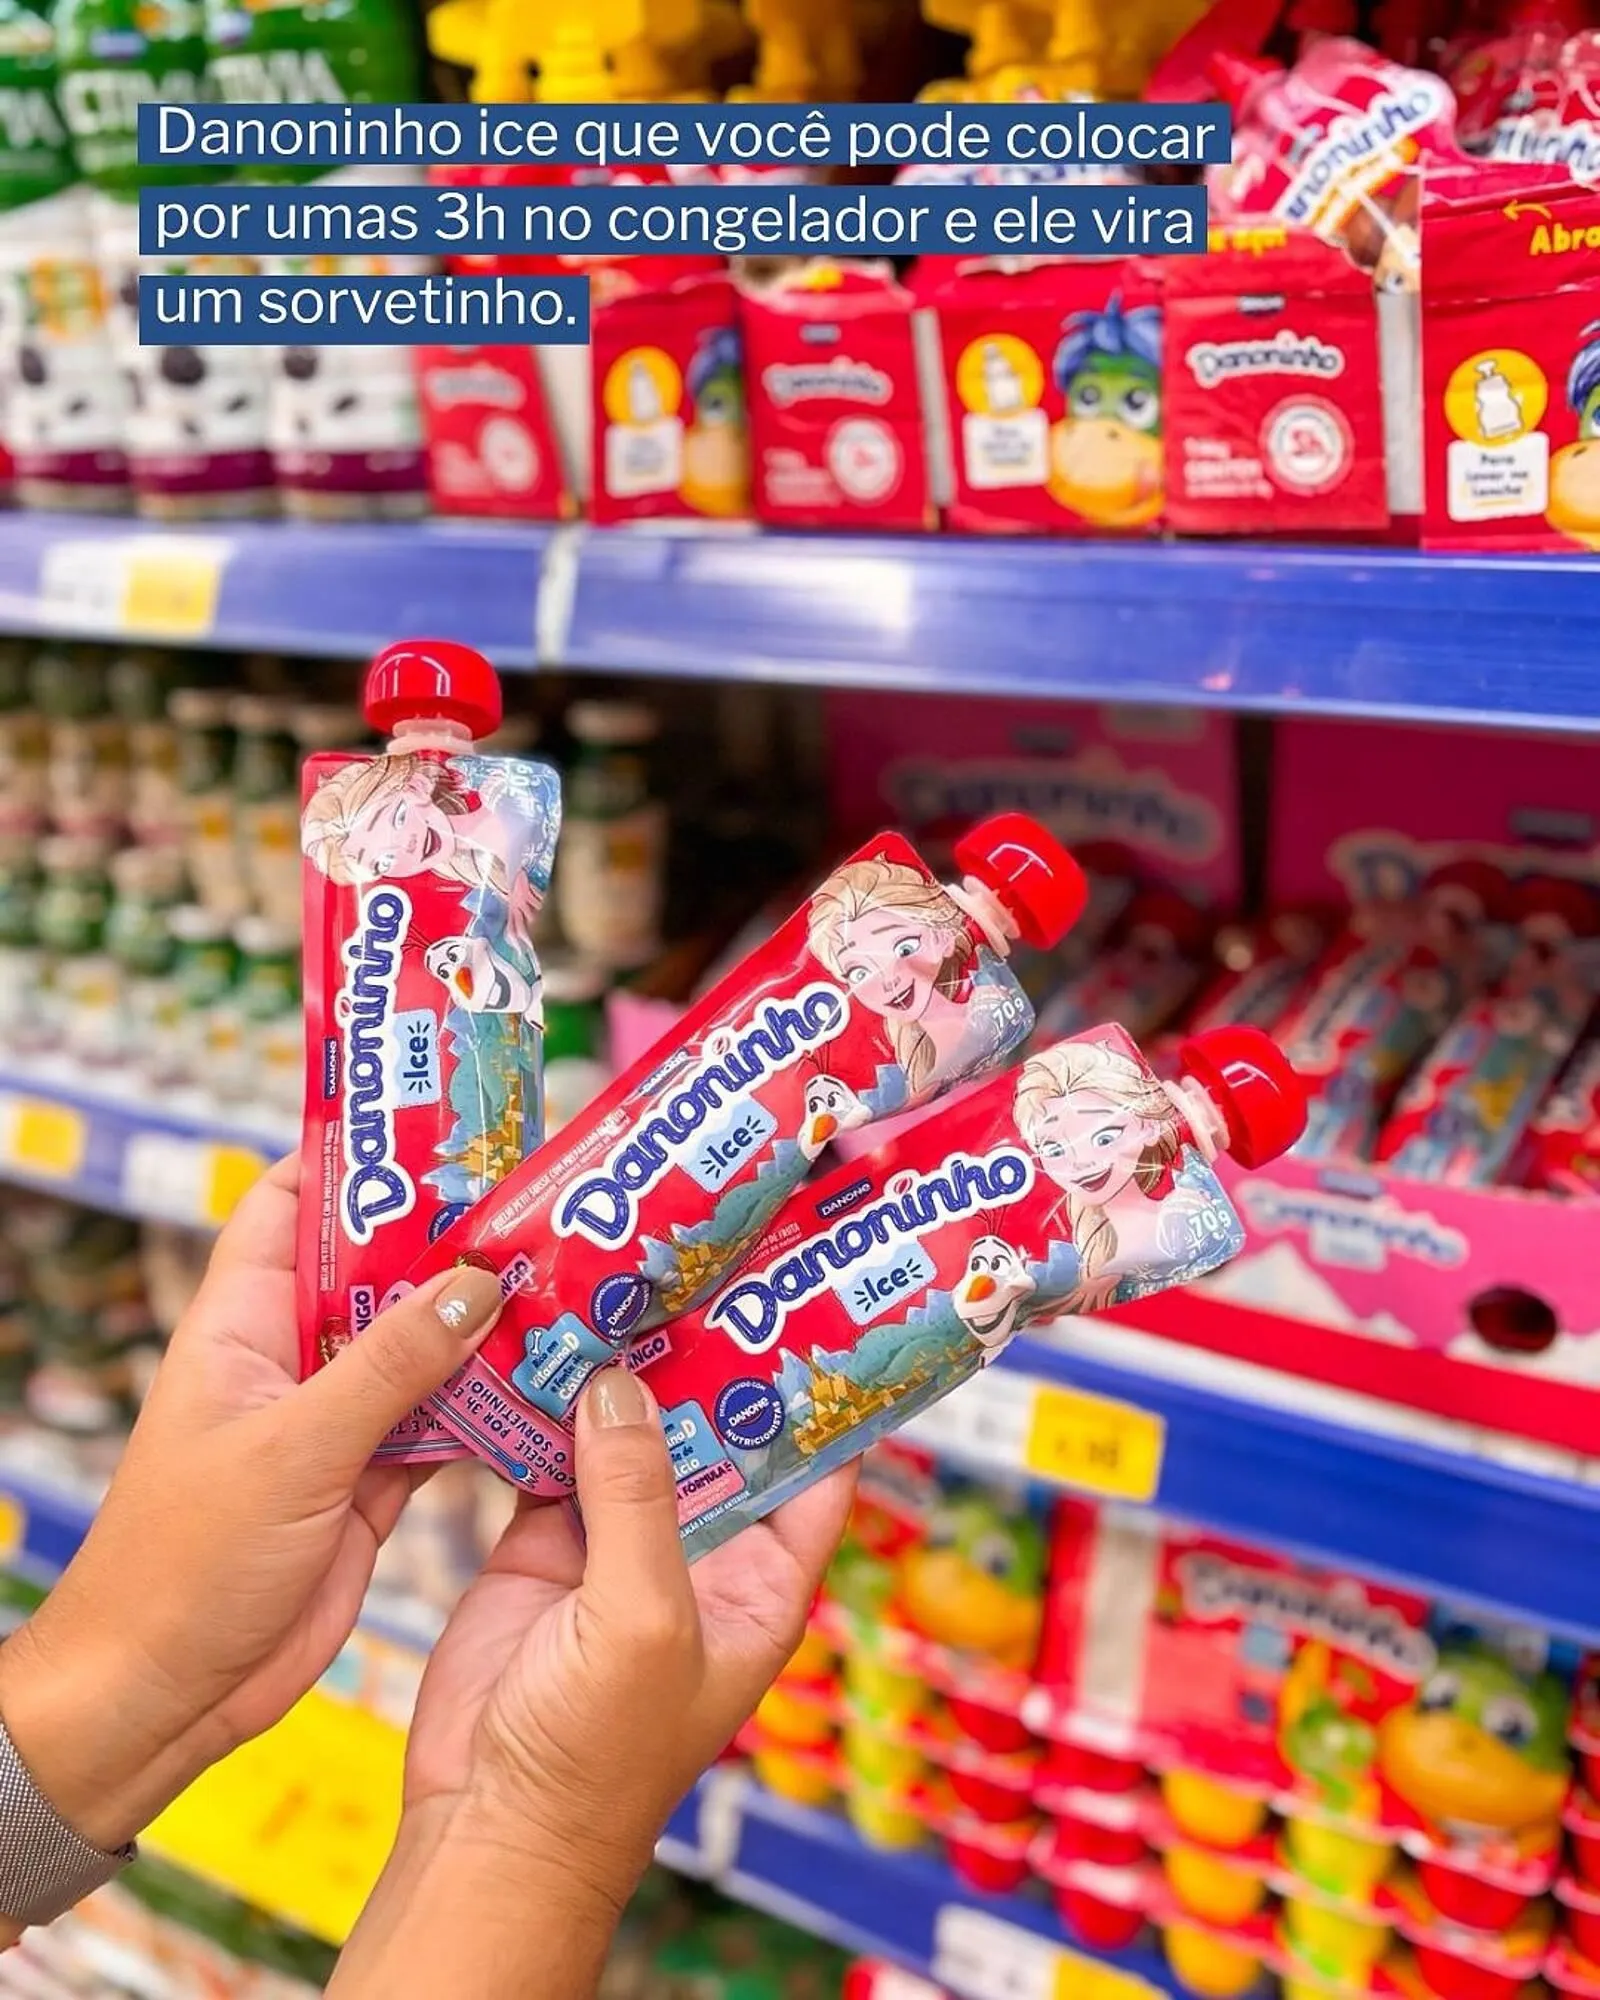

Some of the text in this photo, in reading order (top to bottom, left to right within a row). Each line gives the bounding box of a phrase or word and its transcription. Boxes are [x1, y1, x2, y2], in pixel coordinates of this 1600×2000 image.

[992, 996, 1026, 1027] 70g
[338, 892, 408, 1235] Danoninho
[402, 1036, 430, 1081] Ice
[561, 990, 843, 1241] Danoninho
[709, 1124, 751, 1169] Ice
[820, 1182, 871, 1217] DANONE
[1188, 1207, 1231, 1238] 70g
[711, 1154, 1026, 1346] Danoninho
[866, 1266, 910, 1303] Ice
[482, 1411, 511, 1440] POR
[728, 1396, 770, 1428] DANONE
[513, 1439, 578, 1488] CONGELE
